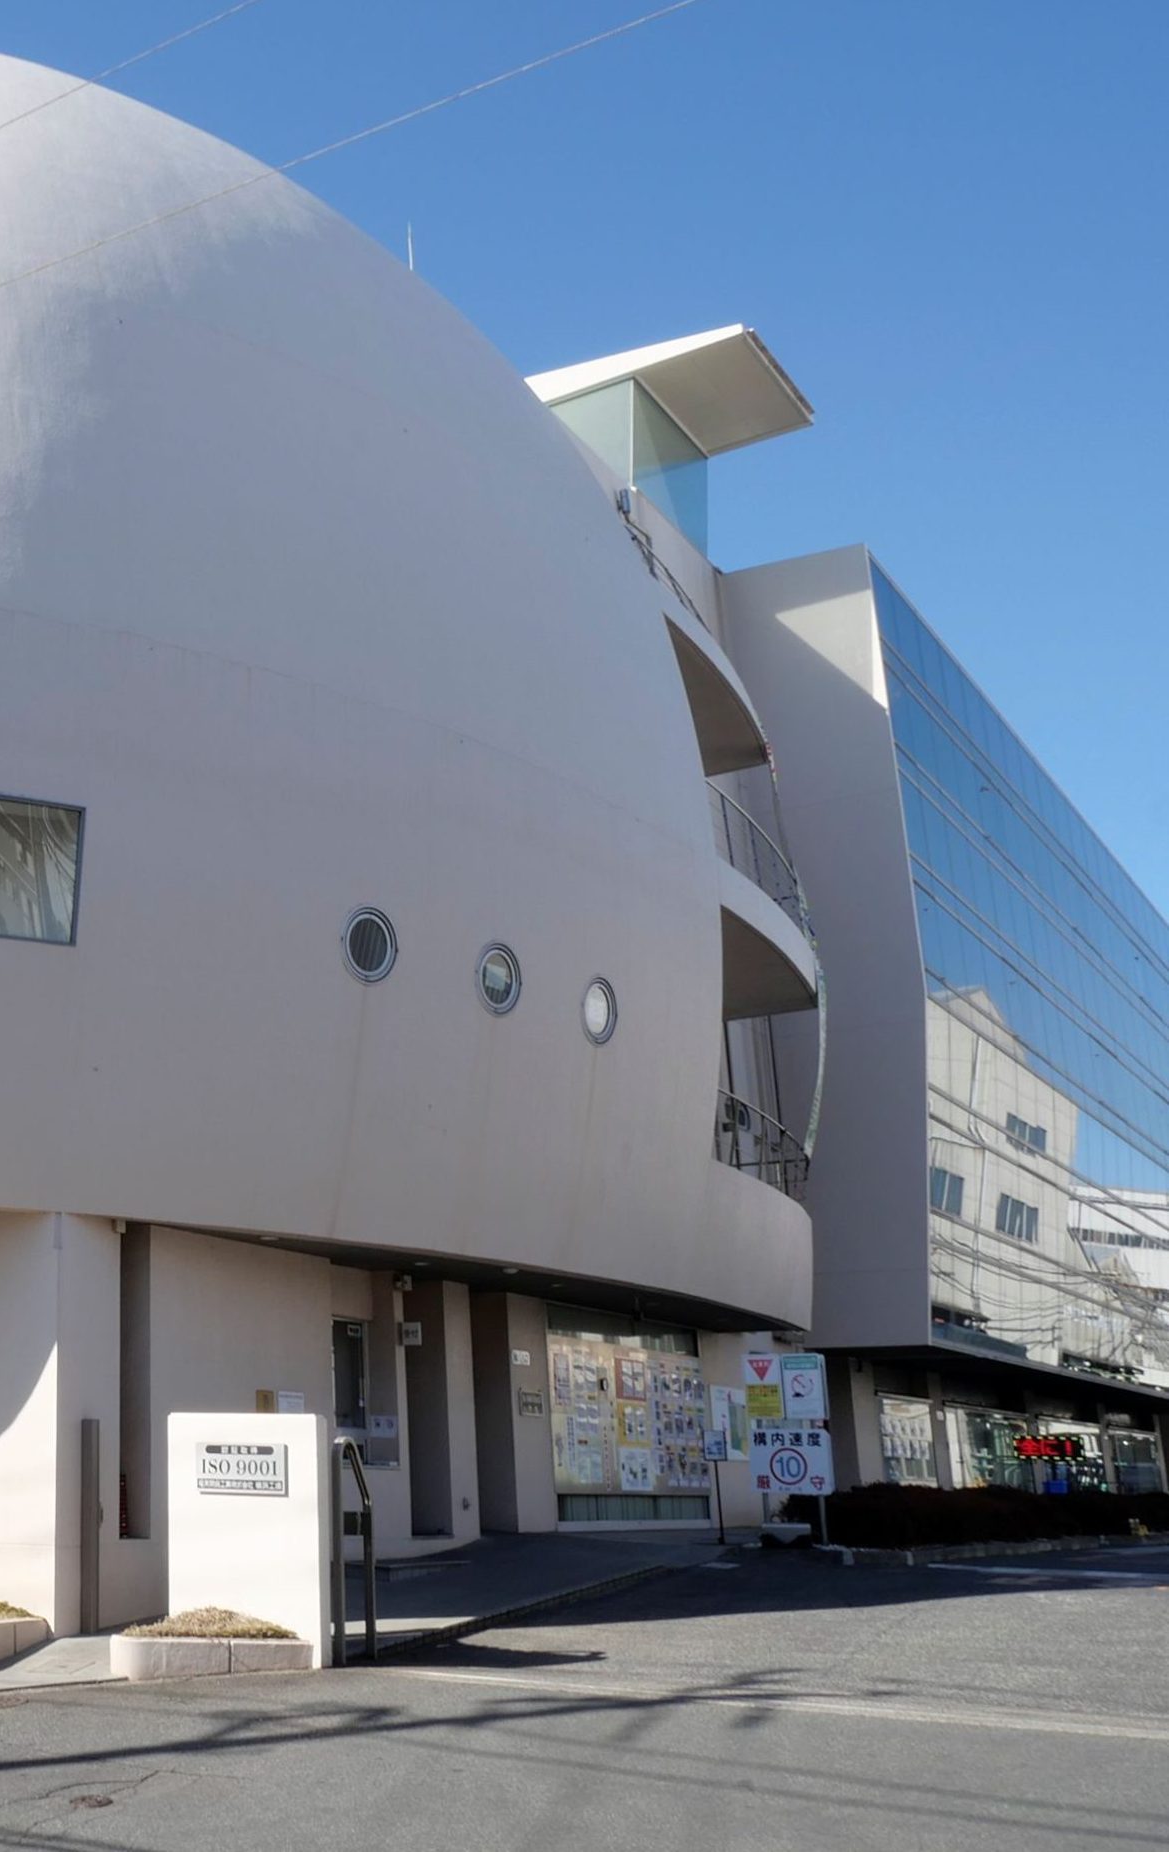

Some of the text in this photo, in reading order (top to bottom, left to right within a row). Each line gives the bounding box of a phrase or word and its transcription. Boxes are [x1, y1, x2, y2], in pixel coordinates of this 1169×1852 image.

[753, 1432, 822, 1448] 構内速度
[202, 1458, 277, 1476] ISO 9001
[776, 1456, 802, 1479] 10
